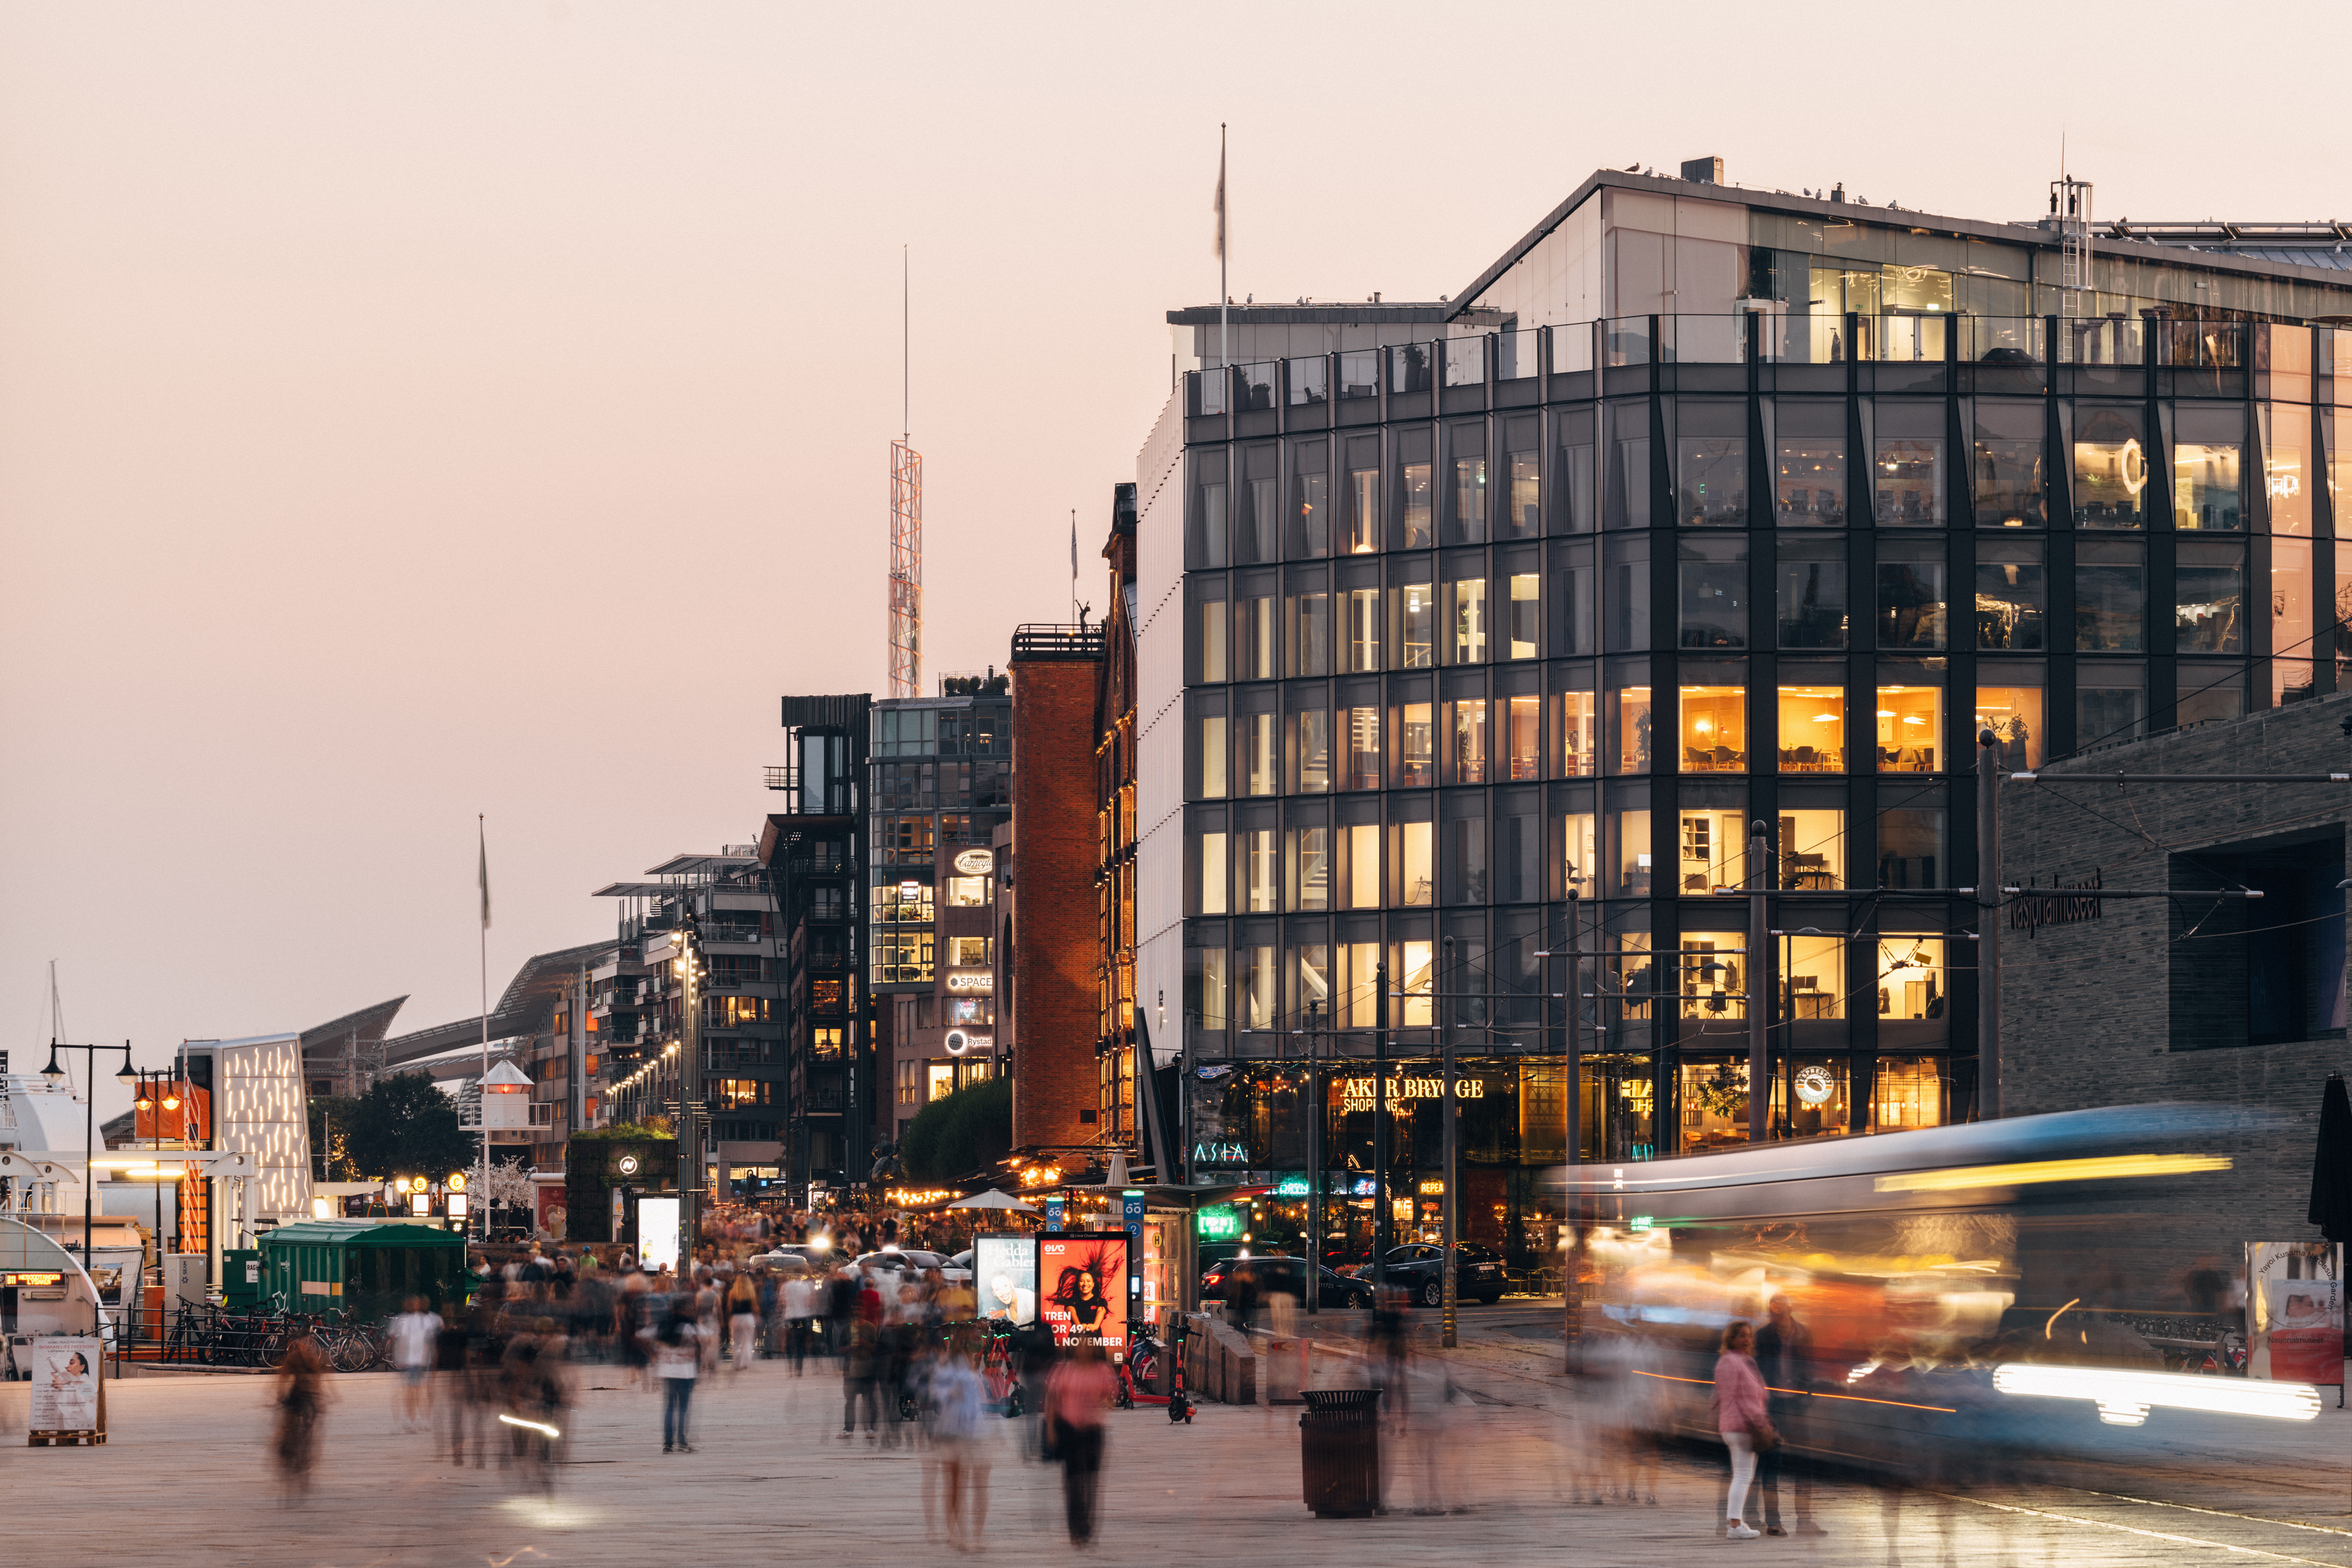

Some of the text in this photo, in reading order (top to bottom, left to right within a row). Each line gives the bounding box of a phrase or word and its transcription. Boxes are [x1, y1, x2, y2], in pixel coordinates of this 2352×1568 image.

[2009, 867, 2101, 939] Nasjonalmuseet
[960, 977, 992, 986] SPACE
[1802, 1092, 1827, 1102] HOUSE
[1194, 1143, 1245, 1161] ASIA
[1421, 1183, 1443, 1192] REPEA
[1154, 1236, 1160, 1245] H
[988, 1243, 1028, 1256] Hedda
[7, 1275, 16, 1285] B11
[2258, 1256, 2276, 1275] Yayoi
[2274, 1250, 2305, 1260] Kusama
[2307, 1251, 2334, 1281] Narcissus
[2327, 1282, 2337, 1310] Garden
[1044, 1311, 1071, 1320] TREN
[1051, 1324, 1067, 1333] OR
[1063, 1337, 1123, 1346] NOVEMBER
